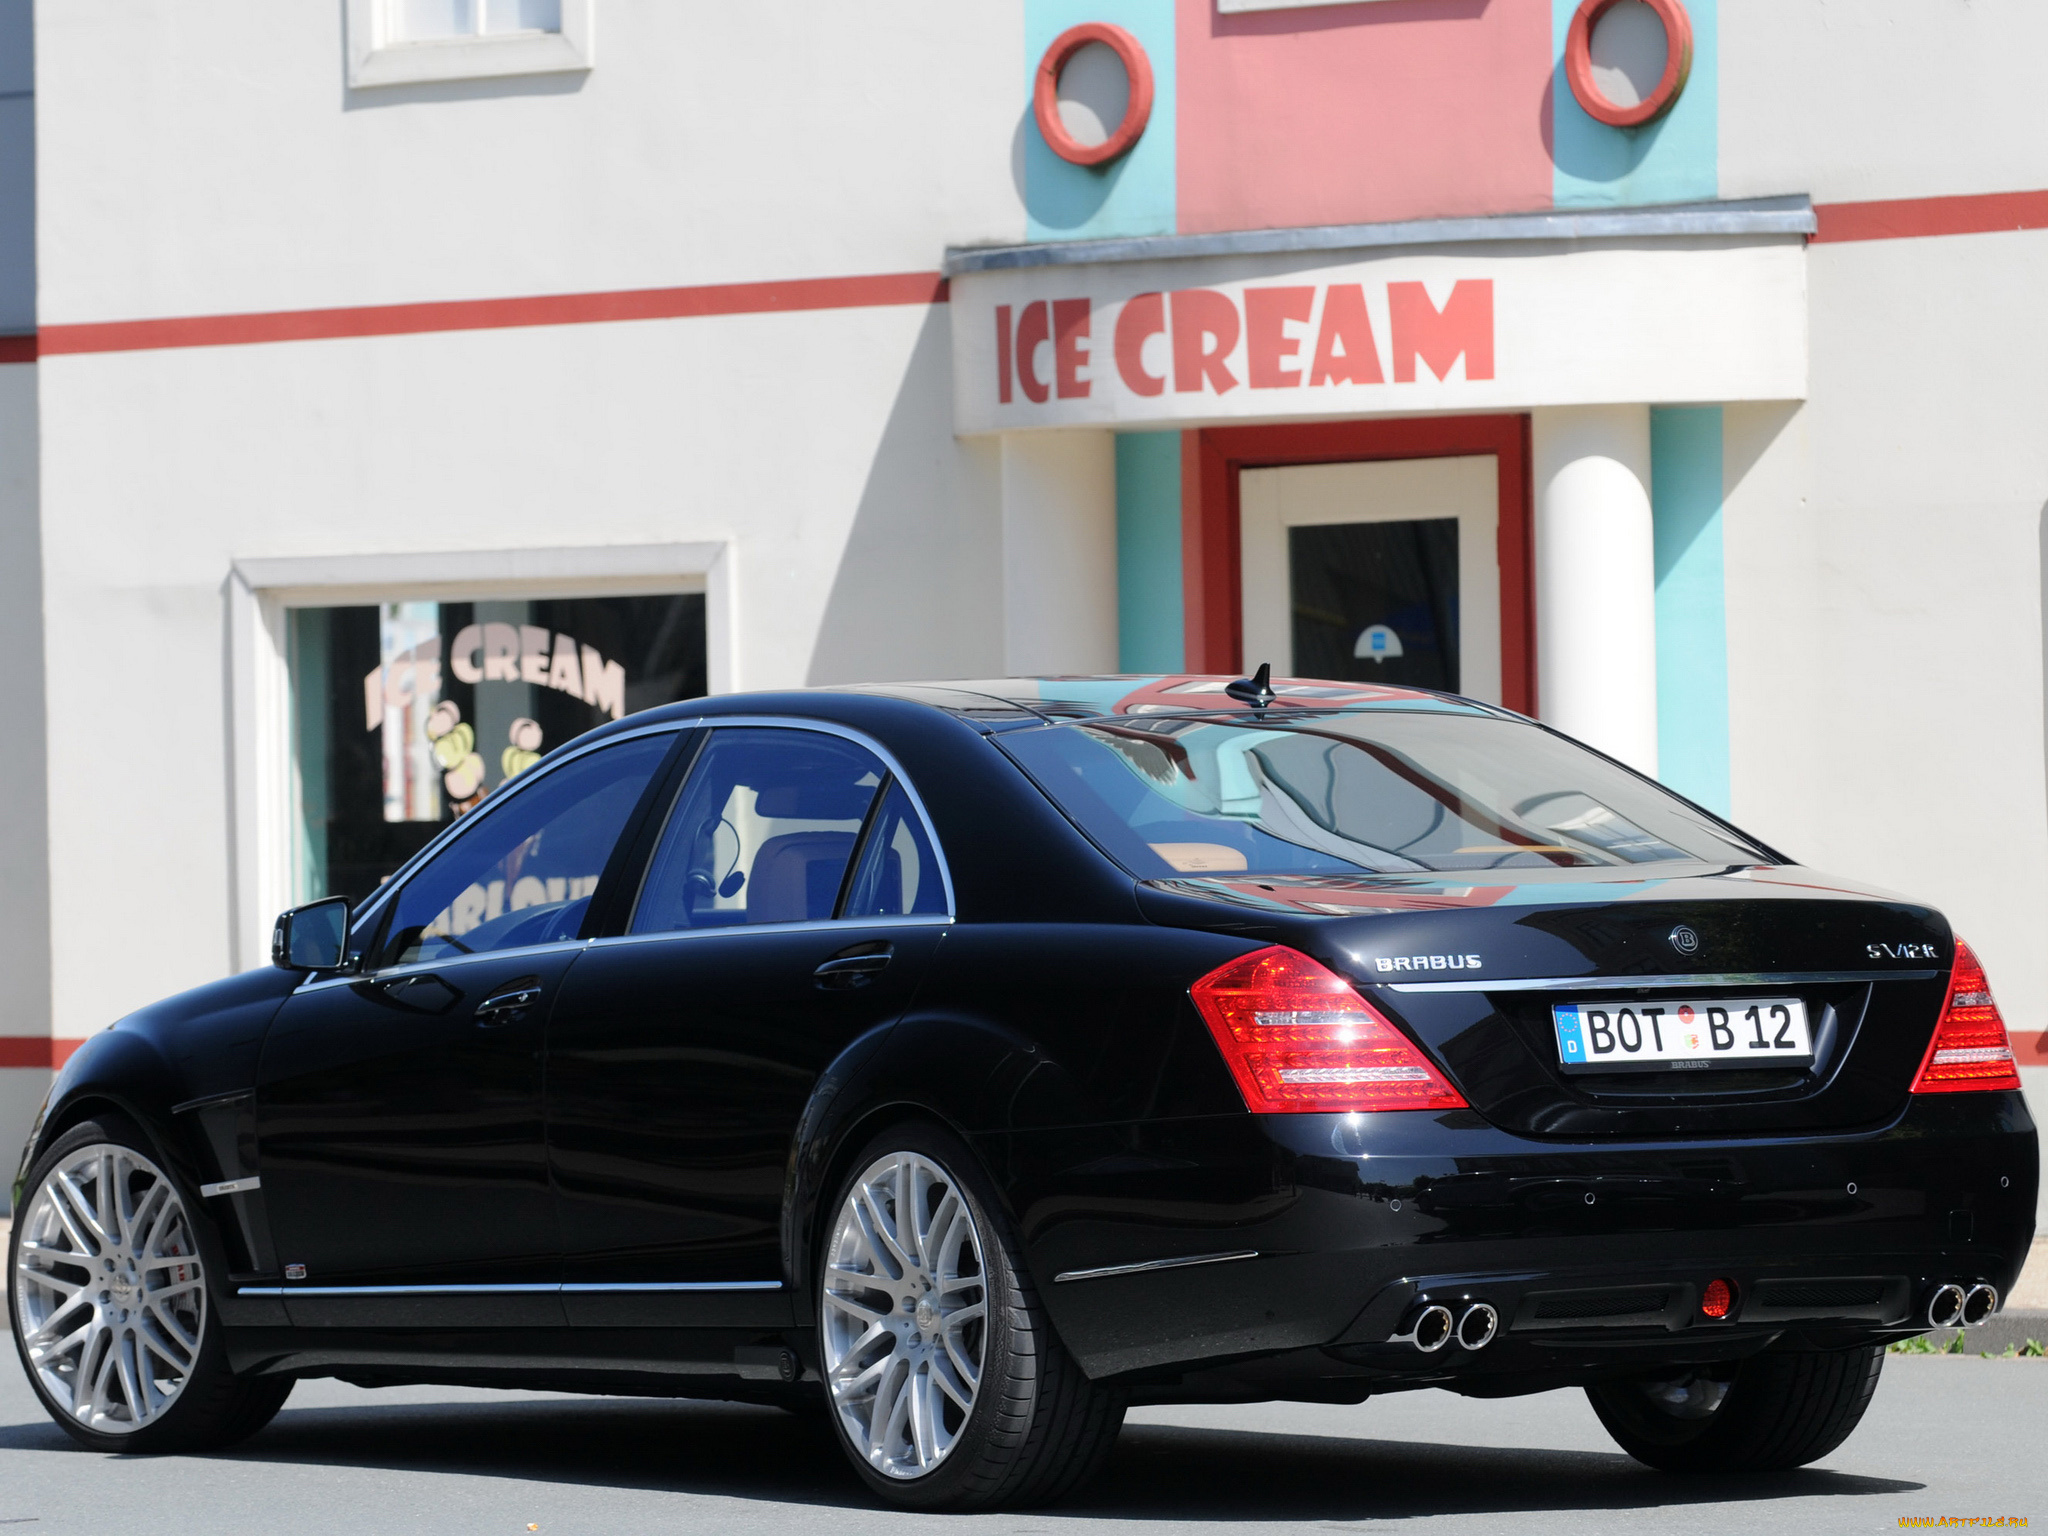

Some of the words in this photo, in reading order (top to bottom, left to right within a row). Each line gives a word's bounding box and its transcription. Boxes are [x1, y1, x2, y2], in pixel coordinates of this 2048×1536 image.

[996, 297, 1091, 404] ICE
[1114, 279, 1495, 397] CREAM
[364, 633, 442, 732] ICE
[451, 622, 625, 720] CREAM
[1375, 954, 1482, 972] BRABUS
[1587, 1007, 1665, 1054] BOT
[1706, 1007, 1735, 1051] B
[1745, 1005, 1796, 1049] 12
[1567, 1040, 1578, 1053] D
[1671, 1061, 1709, 1069] BRABUS
